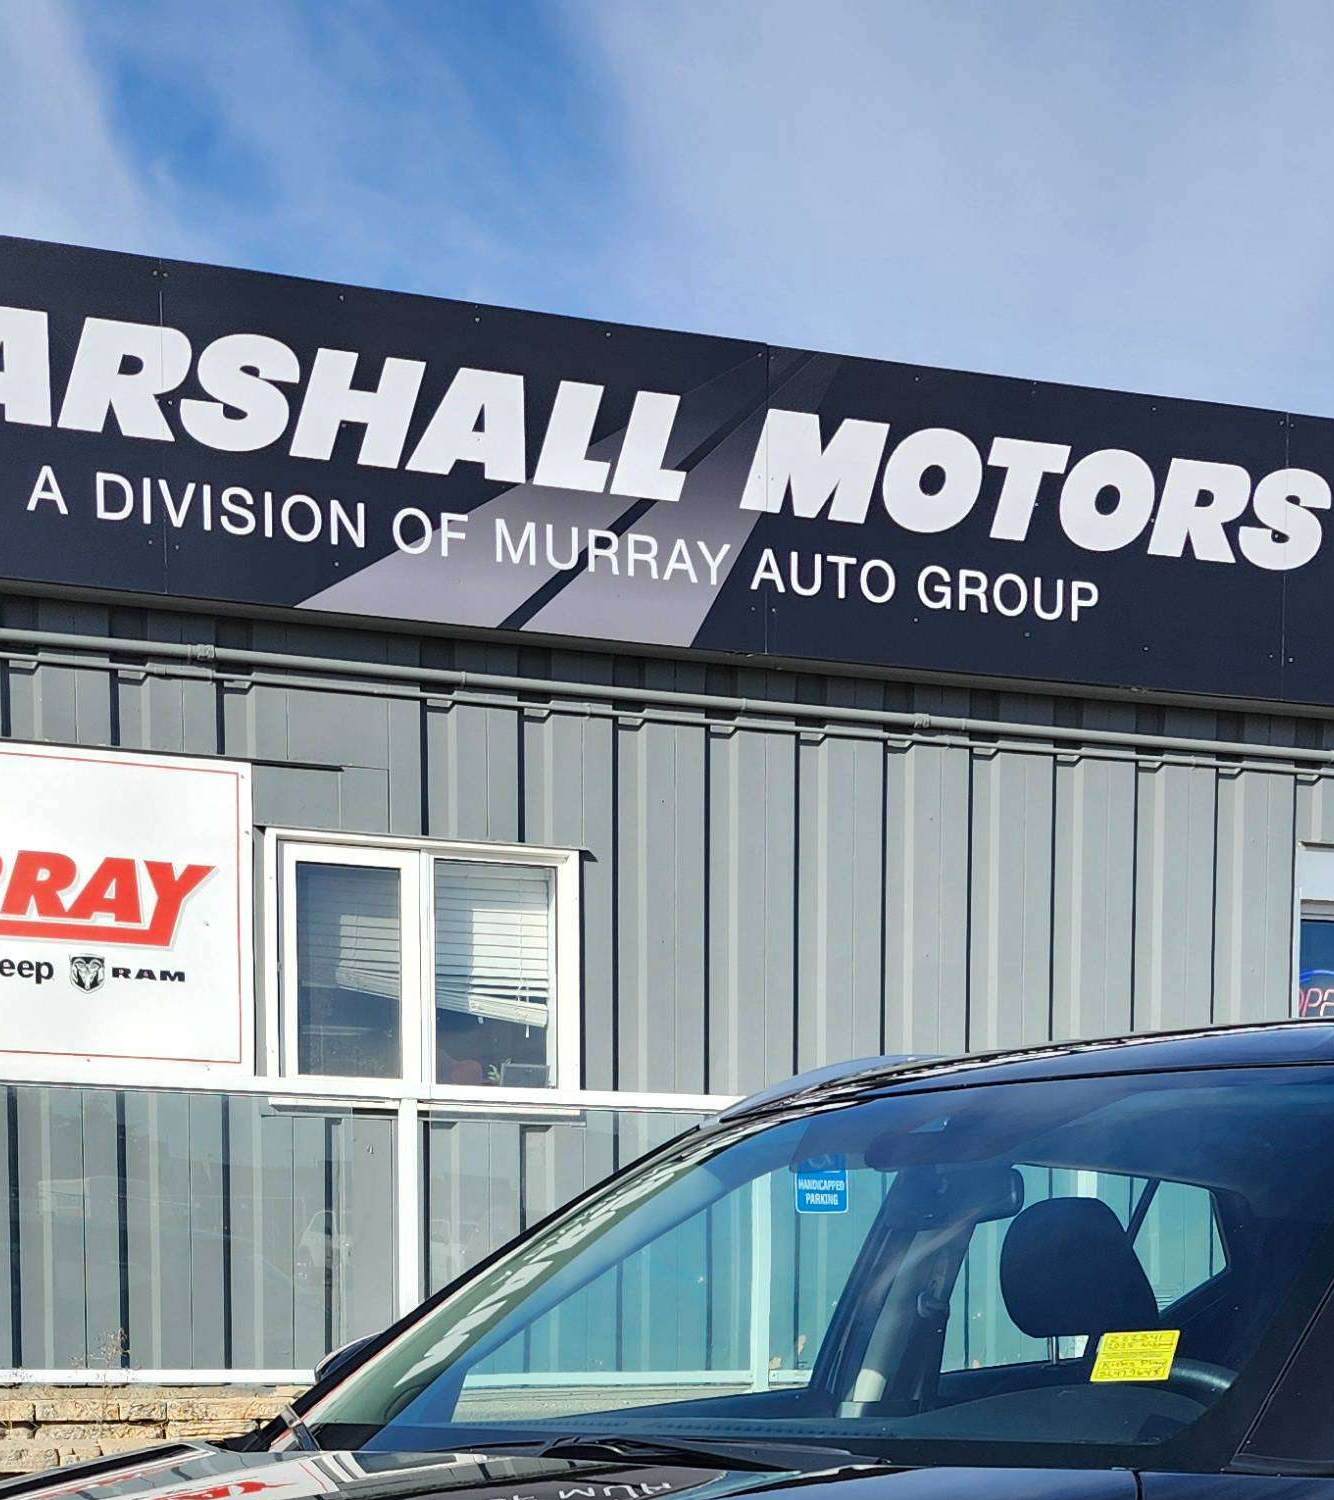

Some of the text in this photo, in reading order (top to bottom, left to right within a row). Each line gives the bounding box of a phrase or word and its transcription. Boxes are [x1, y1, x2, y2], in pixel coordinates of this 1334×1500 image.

[739, 408, 1332, 571] MOTORS
[27, 465, 1099, 622] A DIVISION OF MURRAY AUTO GROUP
[111, 966, 186, 983] RAM
[798, 1178, 845, 1191] HANDICAPPED
[805, 1192, 839, 1206] PARKING
